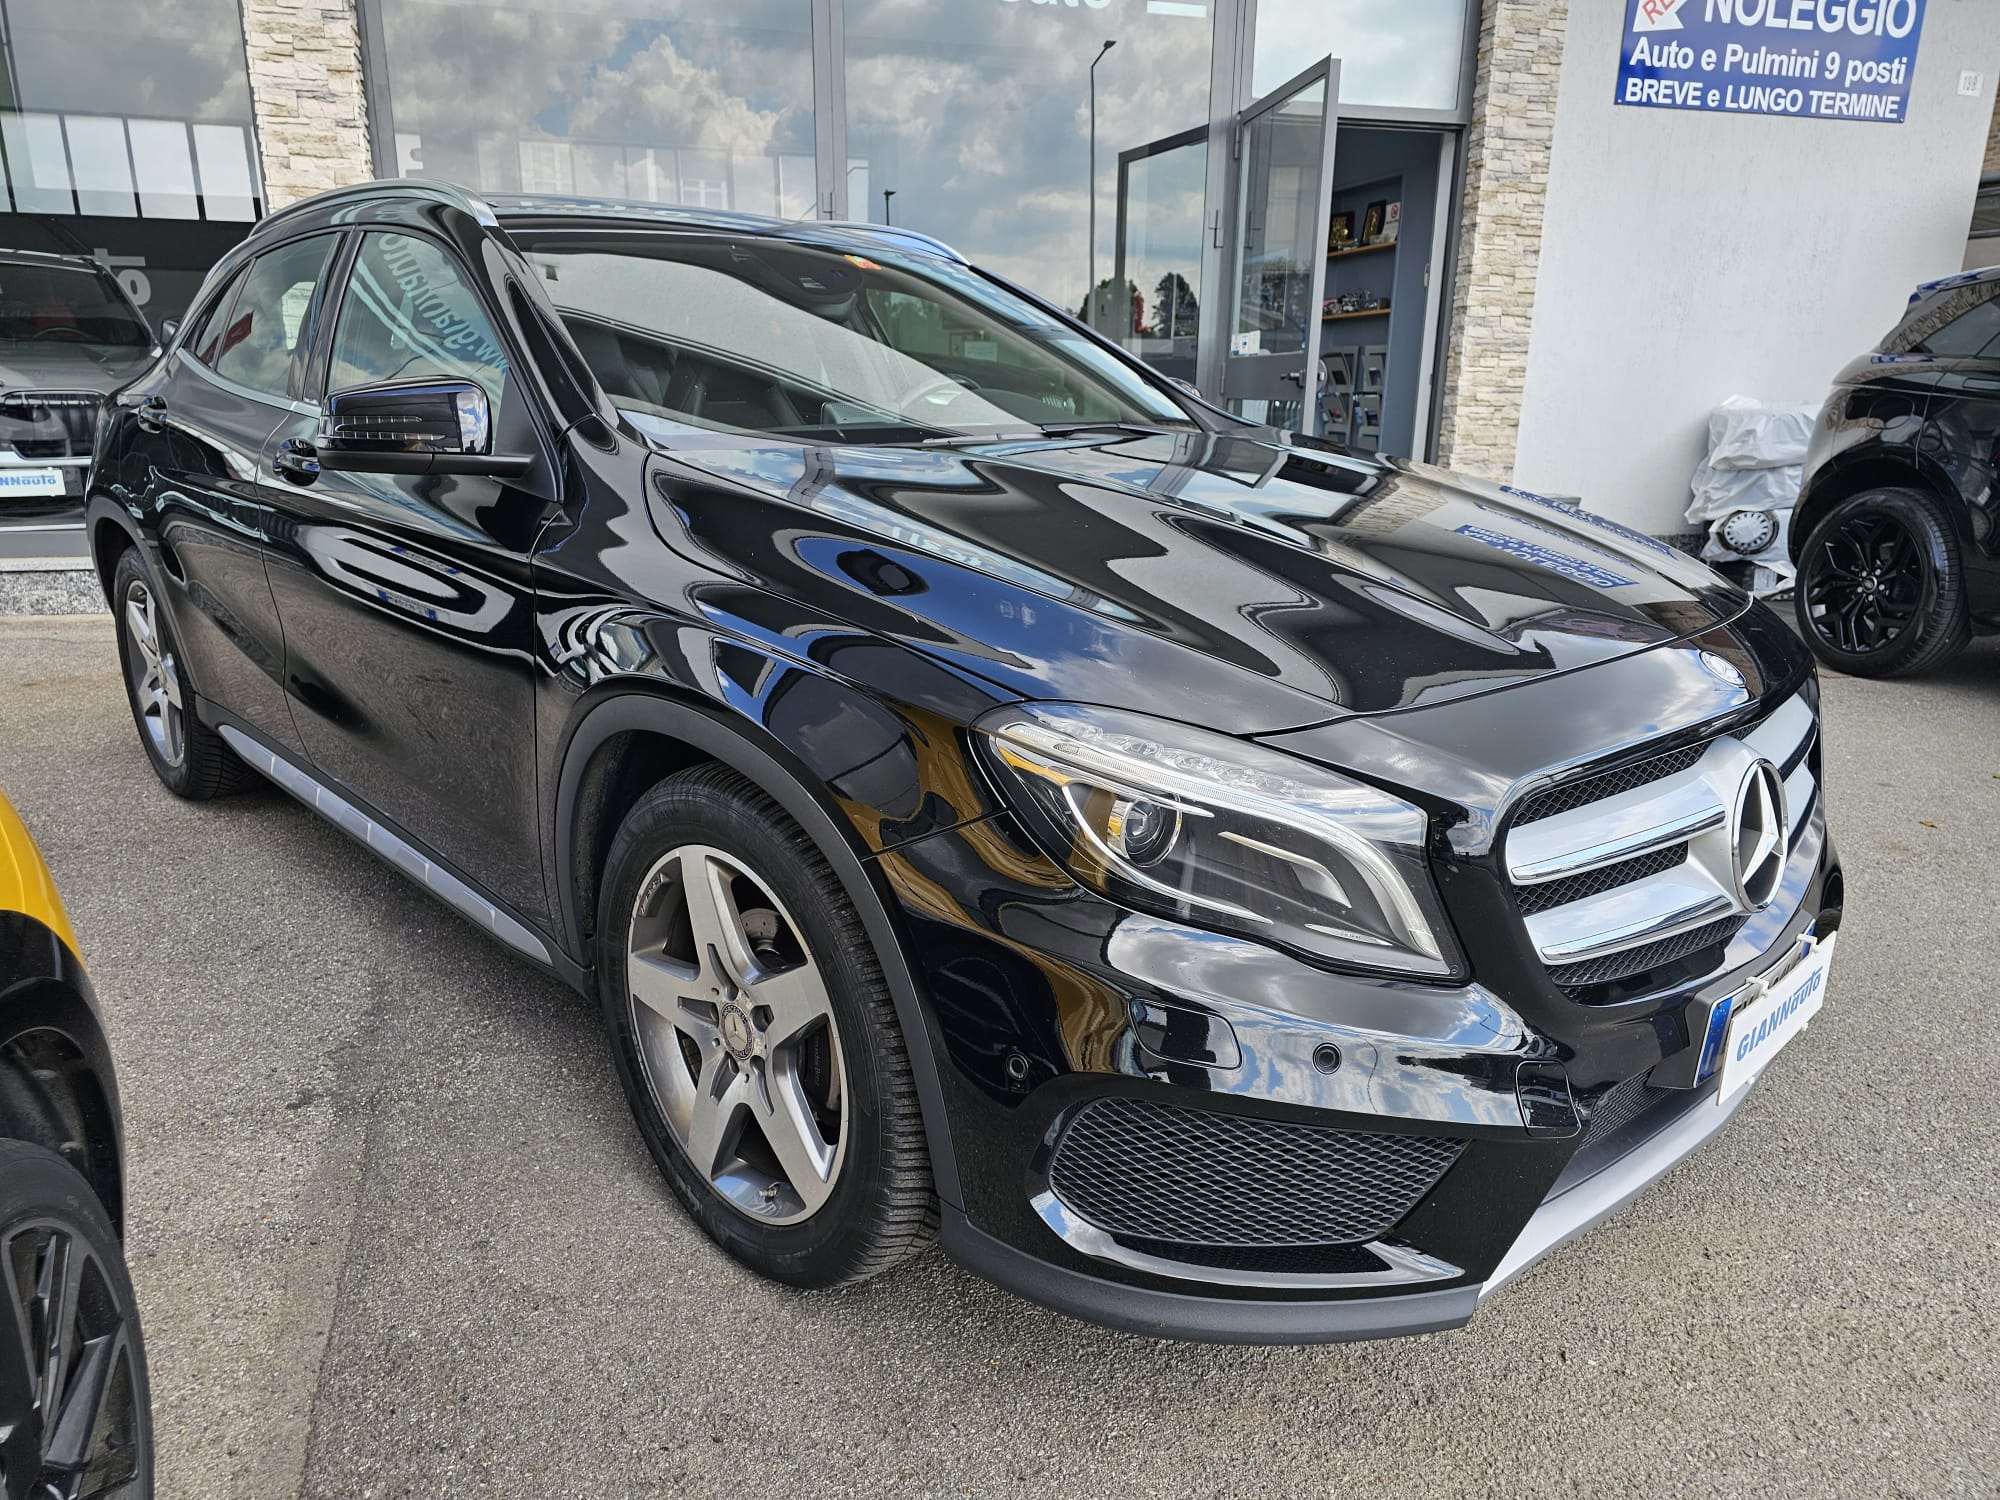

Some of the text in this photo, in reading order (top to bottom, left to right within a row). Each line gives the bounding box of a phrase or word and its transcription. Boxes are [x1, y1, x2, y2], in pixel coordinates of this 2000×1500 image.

[1704, 0, 1917, 38] NOLEGGIO
[1629, 36, 1909, 87] Auto e Pulmini 9 posti
[1624, 78, 1901, 119] BREVE e LUNGO TERMINE
[1736, 965, 1824, 1062] GIANNauto
